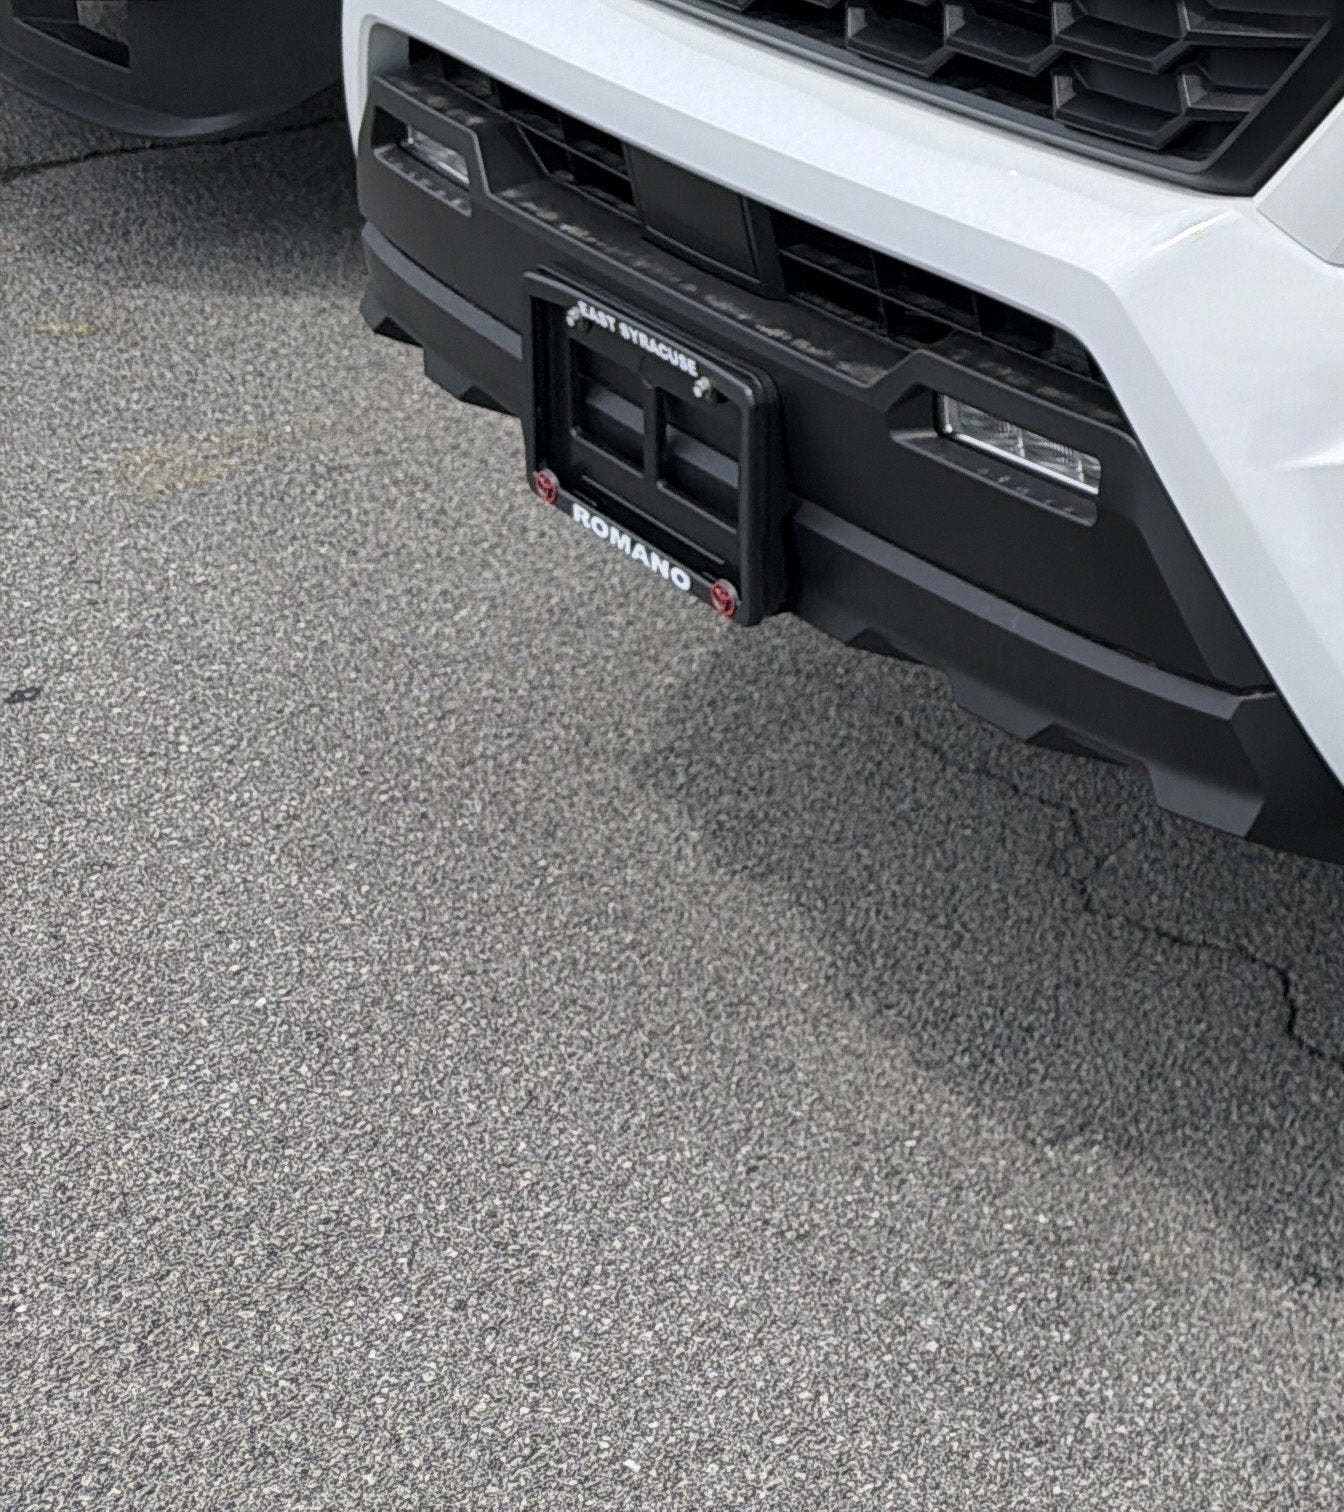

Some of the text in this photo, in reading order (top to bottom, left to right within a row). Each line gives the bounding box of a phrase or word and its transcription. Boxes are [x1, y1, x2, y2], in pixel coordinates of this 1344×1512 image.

[577, 300, 698, 377] EAST SYRACUSE
[572, 502, 691, 591] ROMANO
